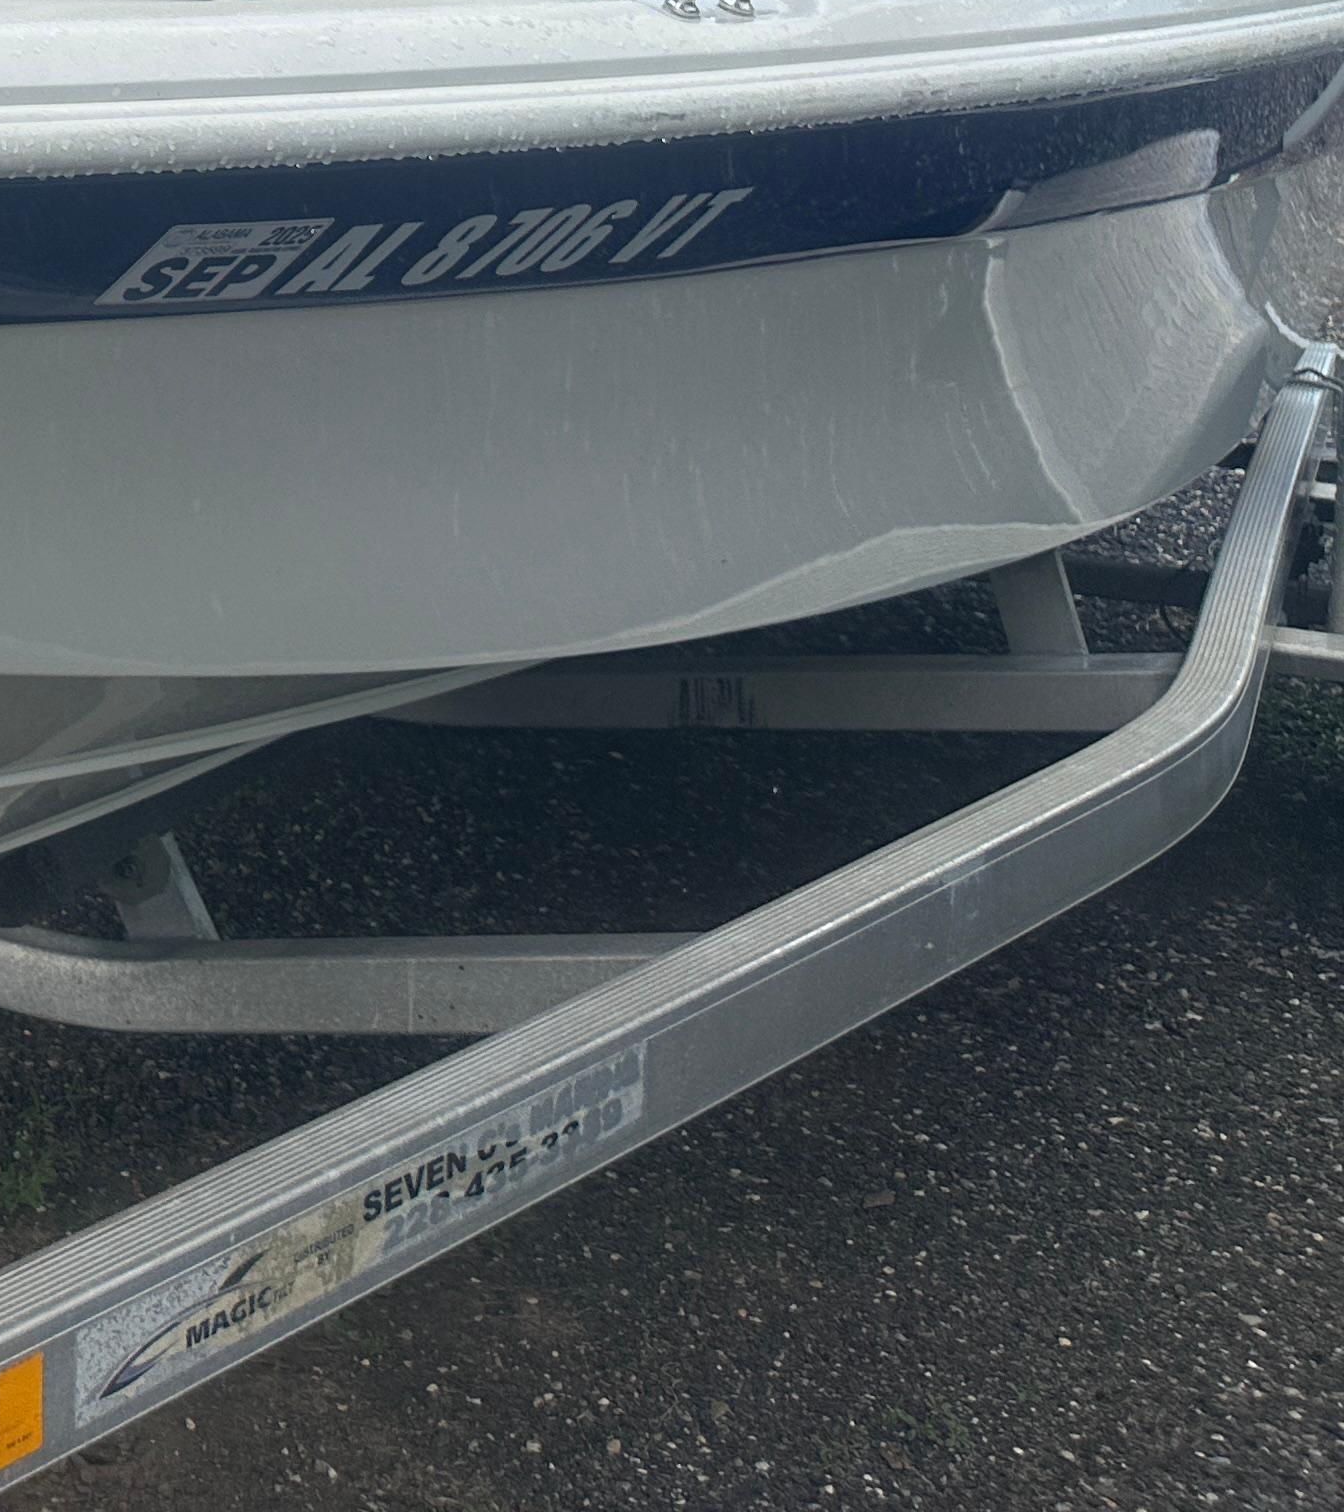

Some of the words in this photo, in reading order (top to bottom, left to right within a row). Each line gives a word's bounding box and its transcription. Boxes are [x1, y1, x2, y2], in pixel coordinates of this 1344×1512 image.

[275, 221, 425, 296] AL
[401, 199, 640, 287] 8706
[608, 186, 756, 264] VT
[122, 253, 278, 302] SEP
[363, 1142, 467, 1223] SEVEN
[185, 1286, 273, 1348] MAGIC
